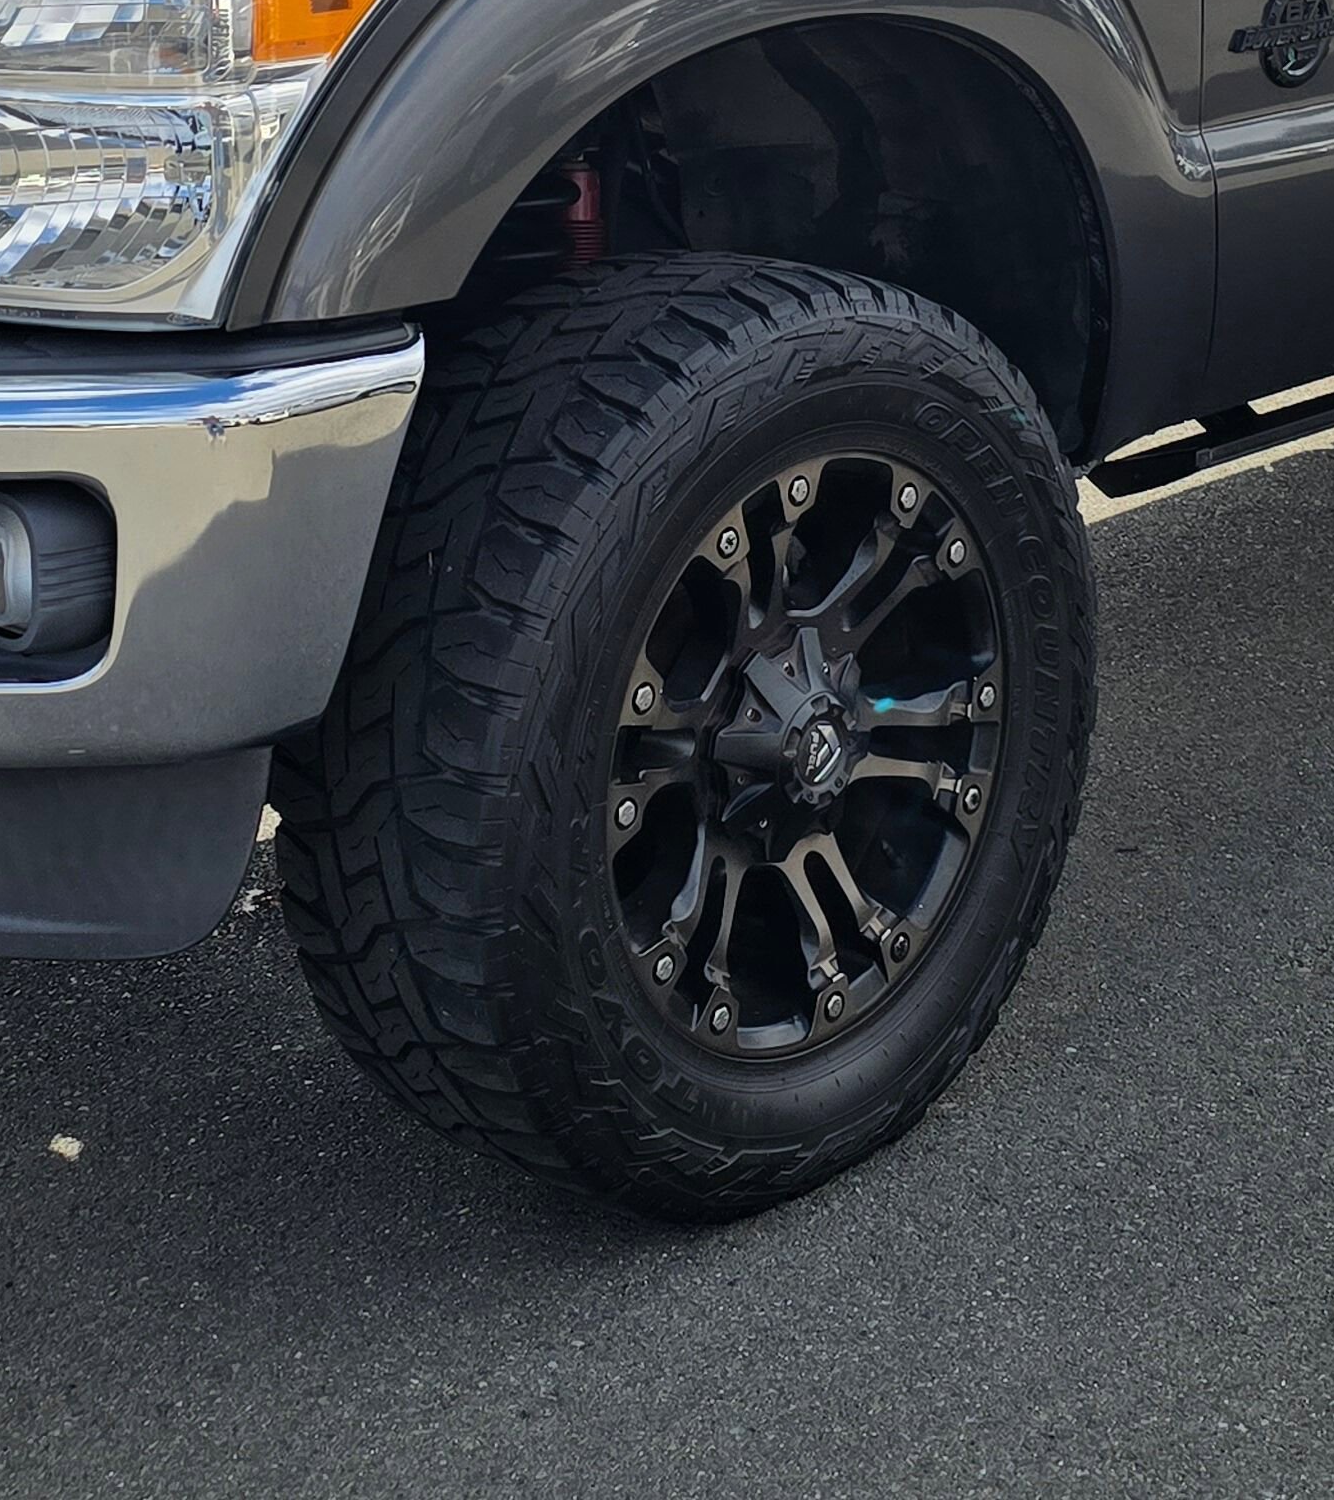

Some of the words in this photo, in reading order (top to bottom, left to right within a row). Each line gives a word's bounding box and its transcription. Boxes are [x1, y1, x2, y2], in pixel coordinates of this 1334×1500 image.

[805, 731, 821, 776] FUEL
[914, 401, 1028, 519] OPEN
[1010, 533, 1062, 874] COUNTRY
